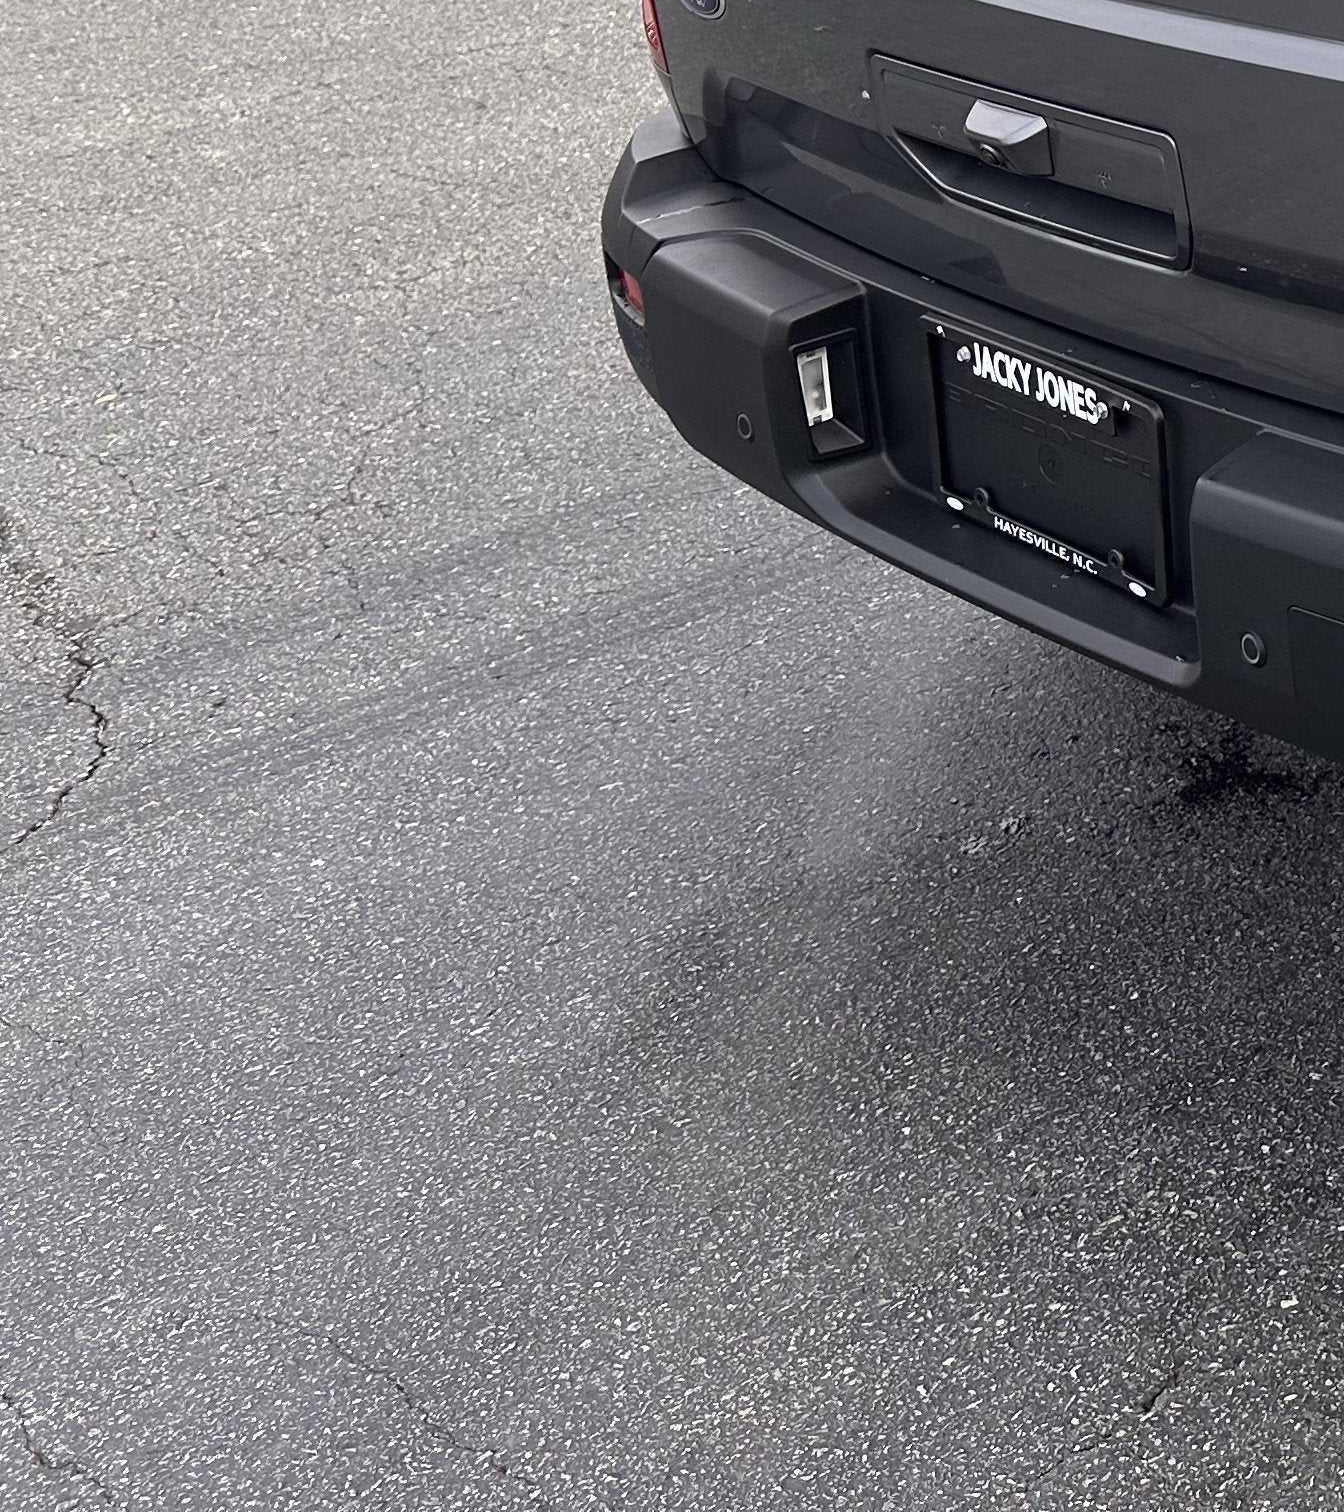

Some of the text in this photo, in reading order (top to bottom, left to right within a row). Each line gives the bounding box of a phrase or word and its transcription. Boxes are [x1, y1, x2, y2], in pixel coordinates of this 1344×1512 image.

[972, 342, 1100, 425] JACKY JONES
[993, 515, 1099, 576] HAYESVILLE, N.C.
